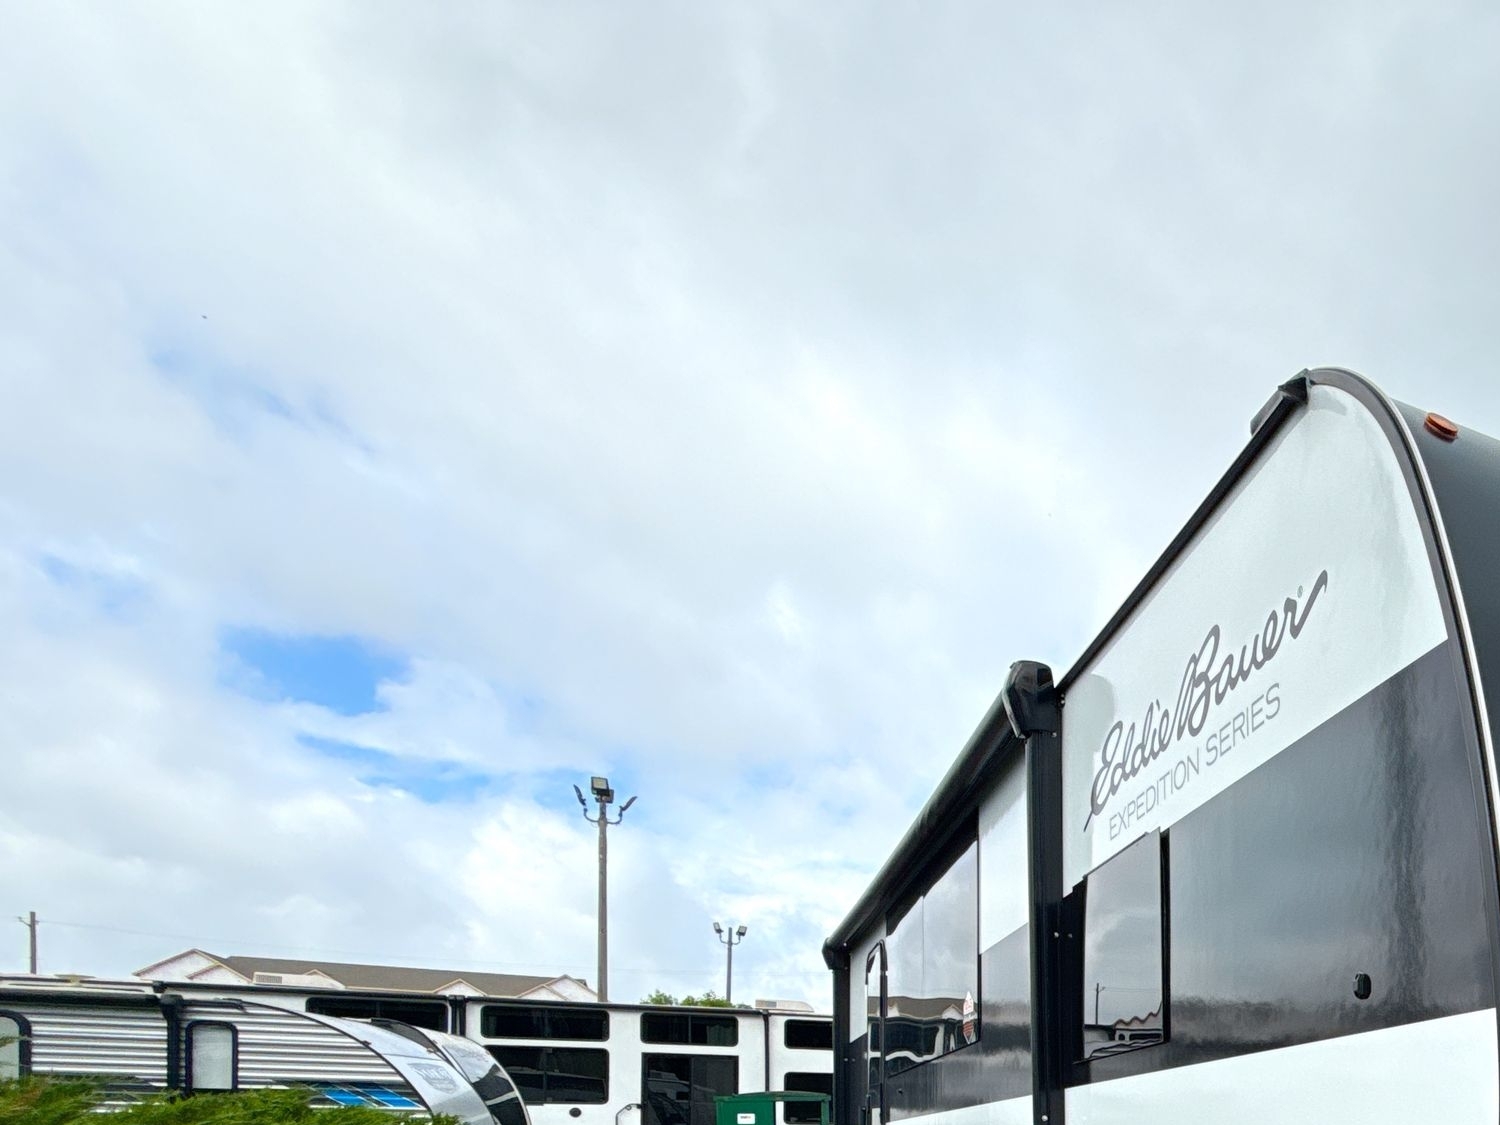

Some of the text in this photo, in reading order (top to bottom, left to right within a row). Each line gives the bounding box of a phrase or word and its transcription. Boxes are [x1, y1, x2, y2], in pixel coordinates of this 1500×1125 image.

[1084, 569, 1328, 832] Eddie Bauer
[1109, 682, 1281, 841] EXPEDITION SERIES
